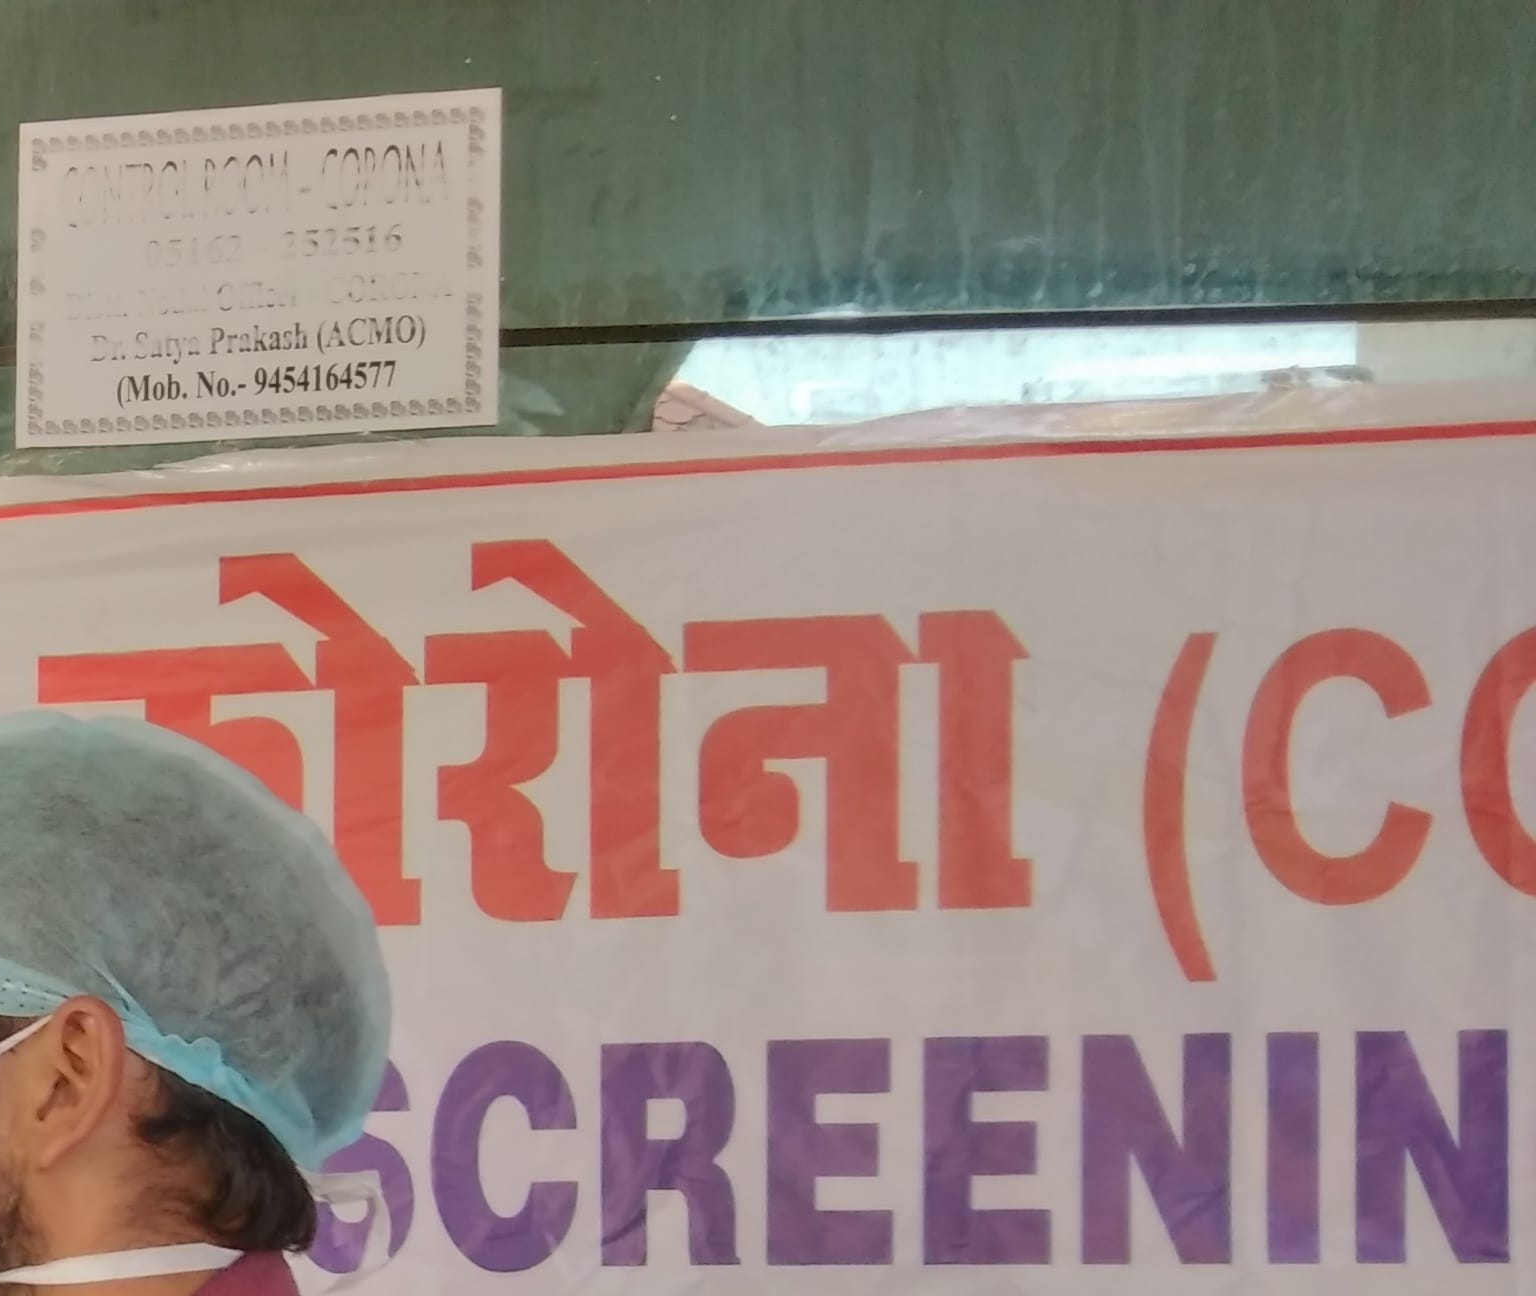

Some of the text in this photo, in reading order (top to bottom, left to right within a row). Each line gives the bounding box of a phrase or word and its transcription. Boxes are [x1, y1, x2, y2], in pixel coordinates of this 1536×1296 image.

[208, 323, 308, 355] Prakash
[316, 314, 426, 354] (ACMO)
[116, 360, 397, 408] (Mob. No.- 9454164577
